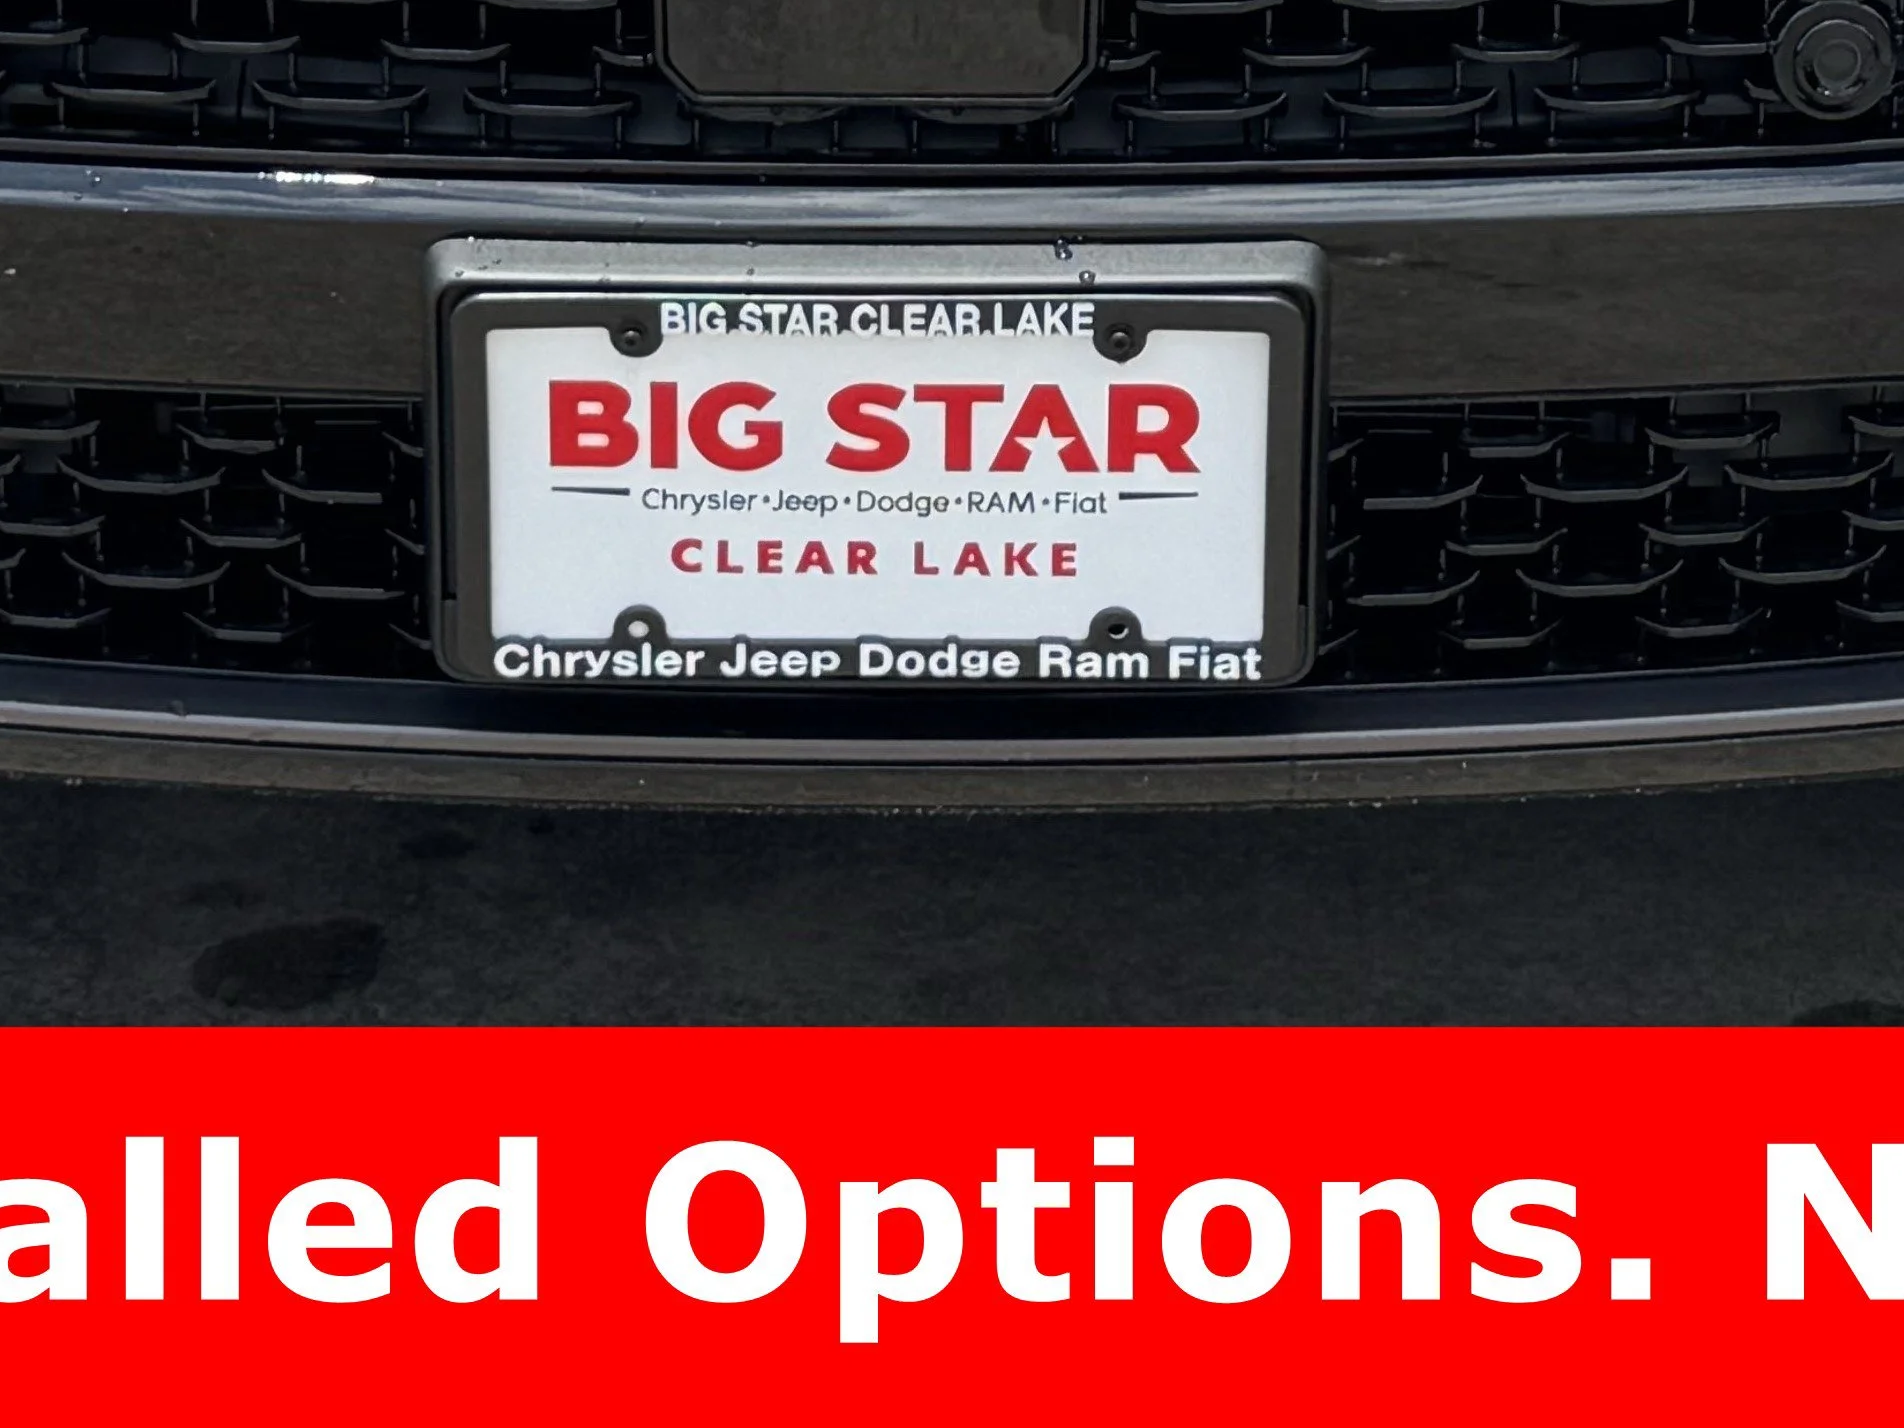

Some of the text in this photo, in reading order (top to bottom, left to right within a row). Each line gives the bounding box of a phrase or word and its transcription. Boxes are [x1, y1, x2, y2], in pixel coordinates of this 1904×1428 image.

[660, 302, 1094, 336] BIG STAR CLEAR LAKE
[549, 380, 1201, 474] BIG STAR
[670, 539, 1078, 577] CLEAR LAKE
[494, 643, 1262, 680] Chrysler Jeep Dodge Ram Fiat
